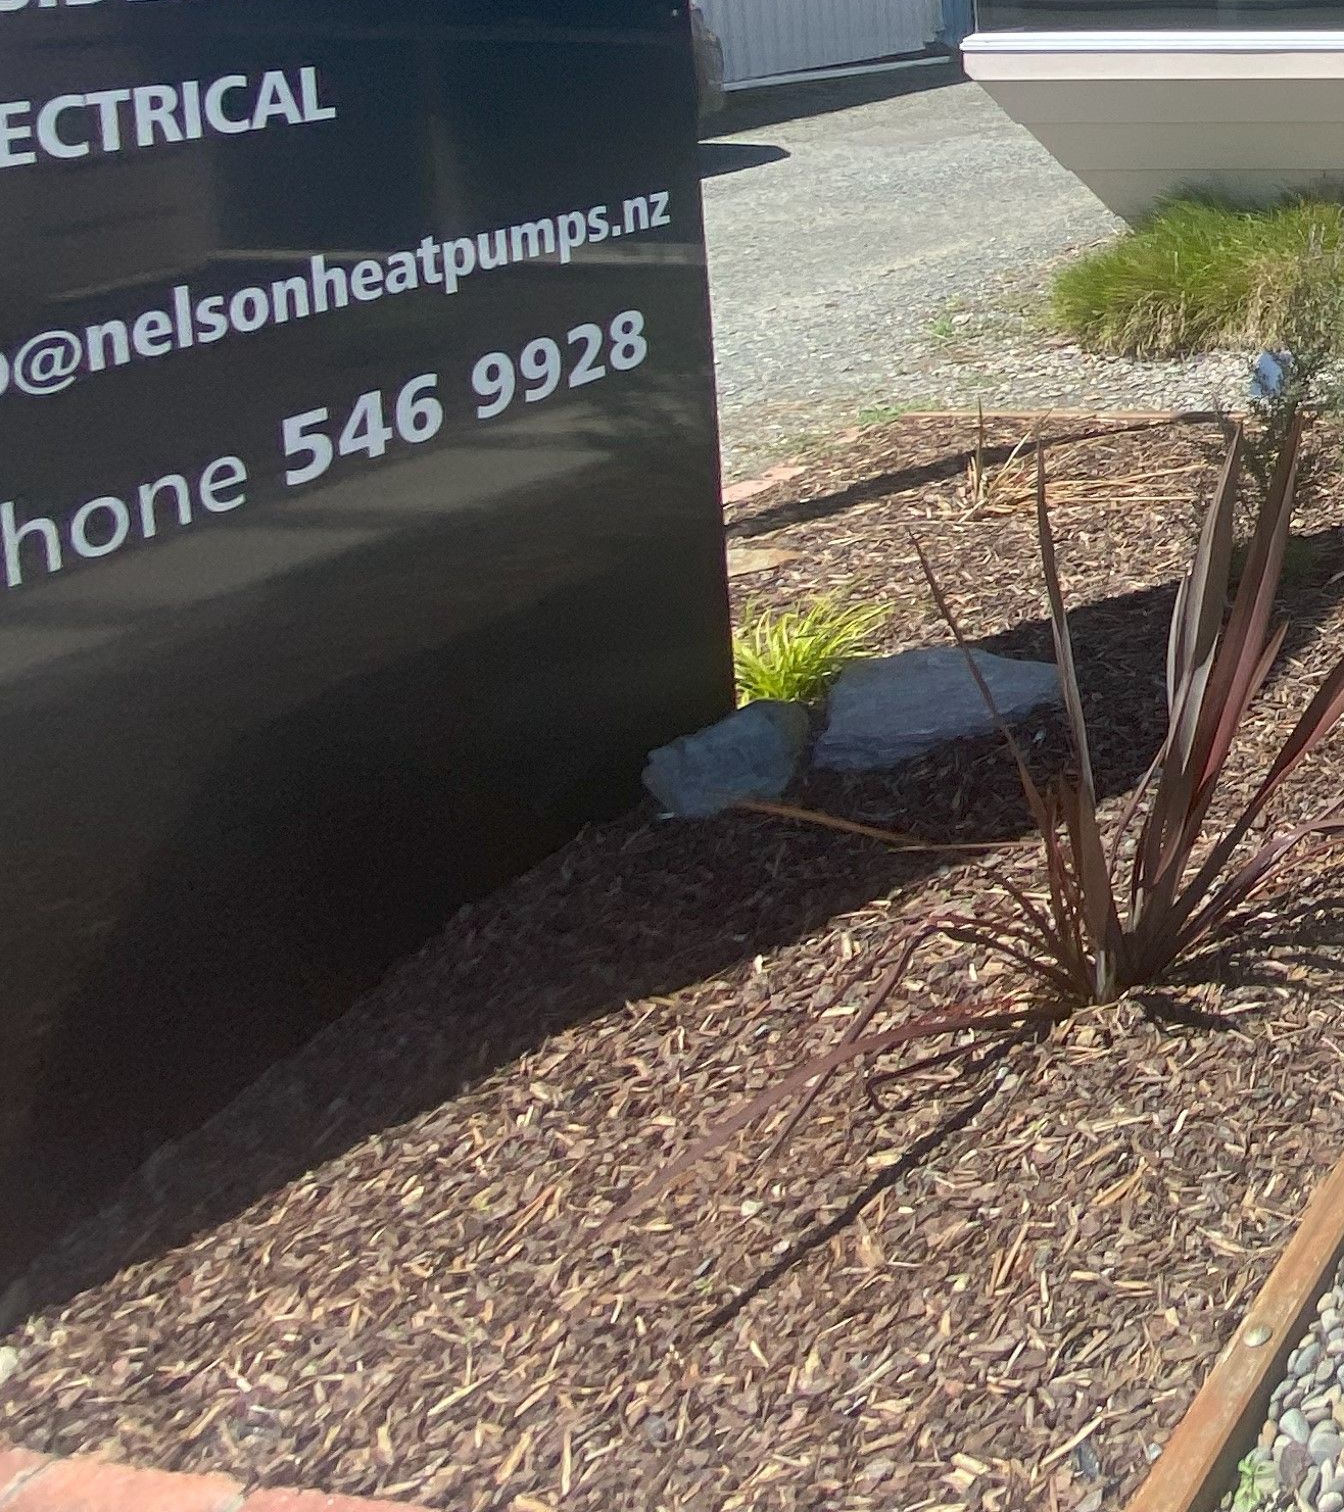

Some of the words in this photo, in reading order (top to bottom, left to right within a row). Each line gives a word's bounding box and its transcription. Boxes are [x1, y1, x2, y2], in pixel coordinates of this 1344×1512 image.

[0, 191, 671, 395] @nelsonheatpumps.nz
[283, 374, 442, 485] 546
[472, 311, 646, 418] 9928
